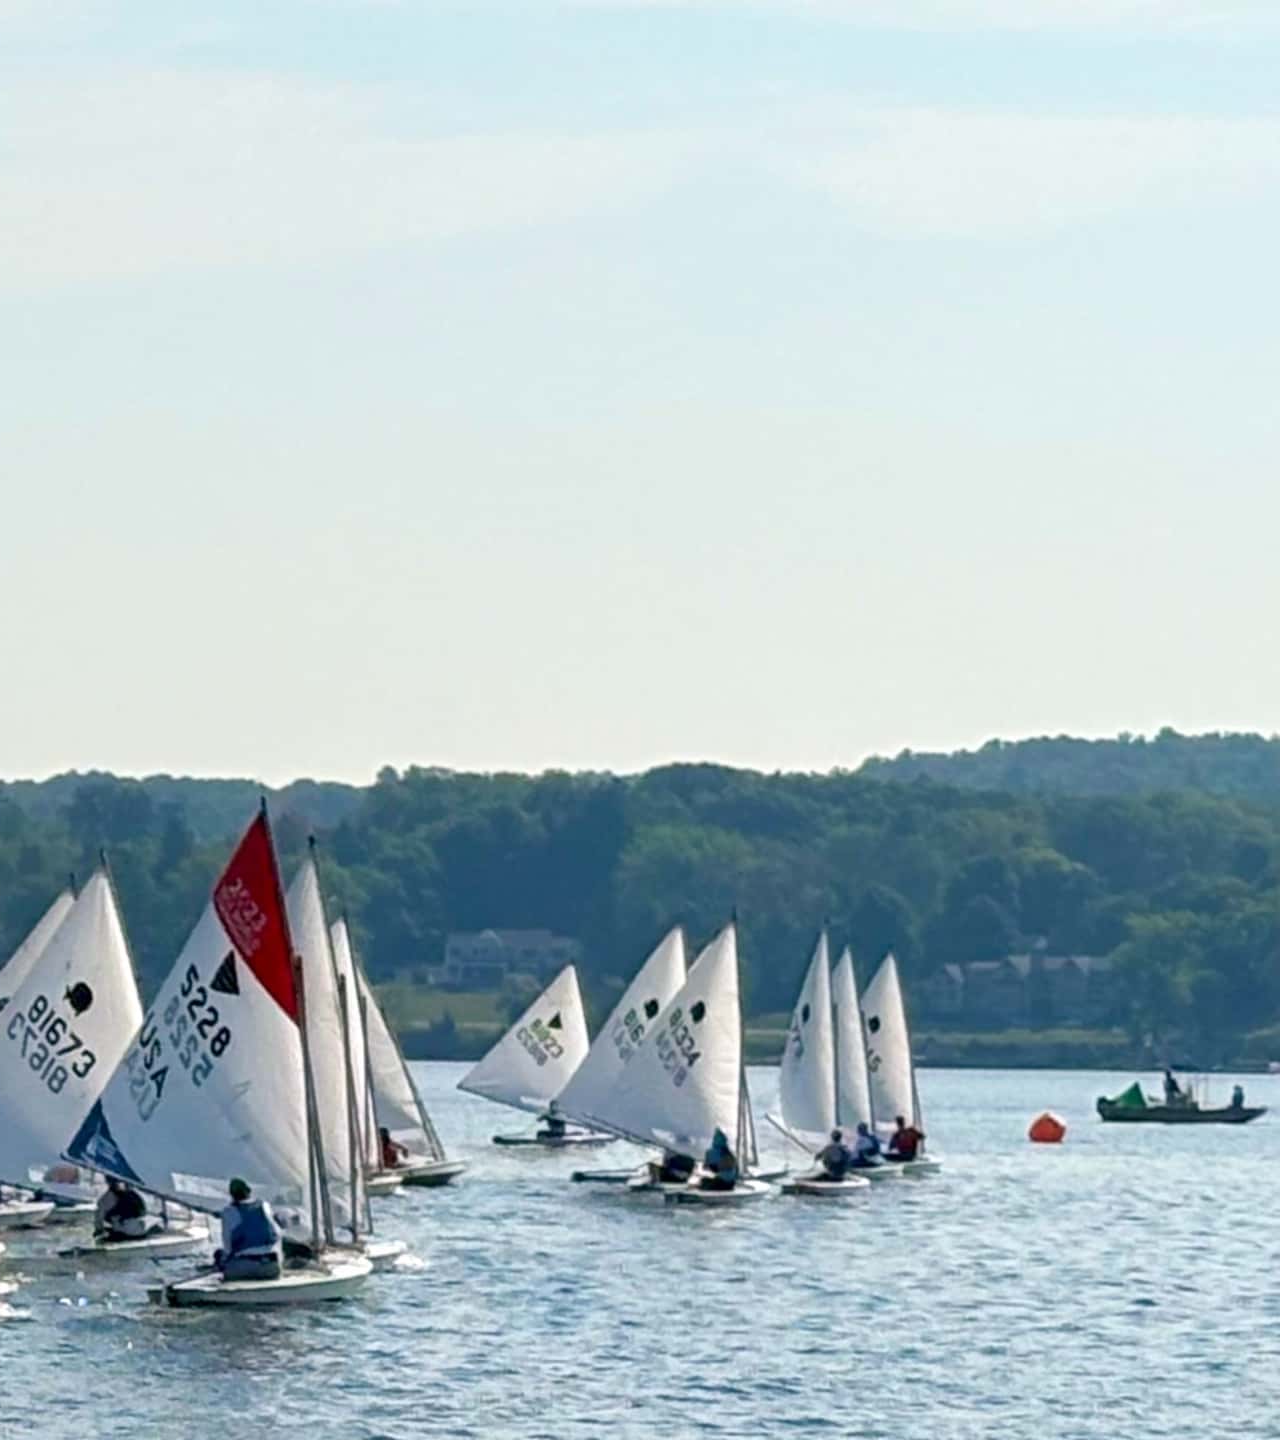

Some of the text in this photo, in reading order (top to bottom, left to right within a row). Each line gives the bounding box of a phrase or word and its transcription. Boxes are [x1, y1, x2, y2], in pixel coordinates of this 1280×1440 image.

[28, 994, 96, 1078] 81673
[181, 963, 231, 1057] 5228
[139, 1012, 168, 1098] USA
